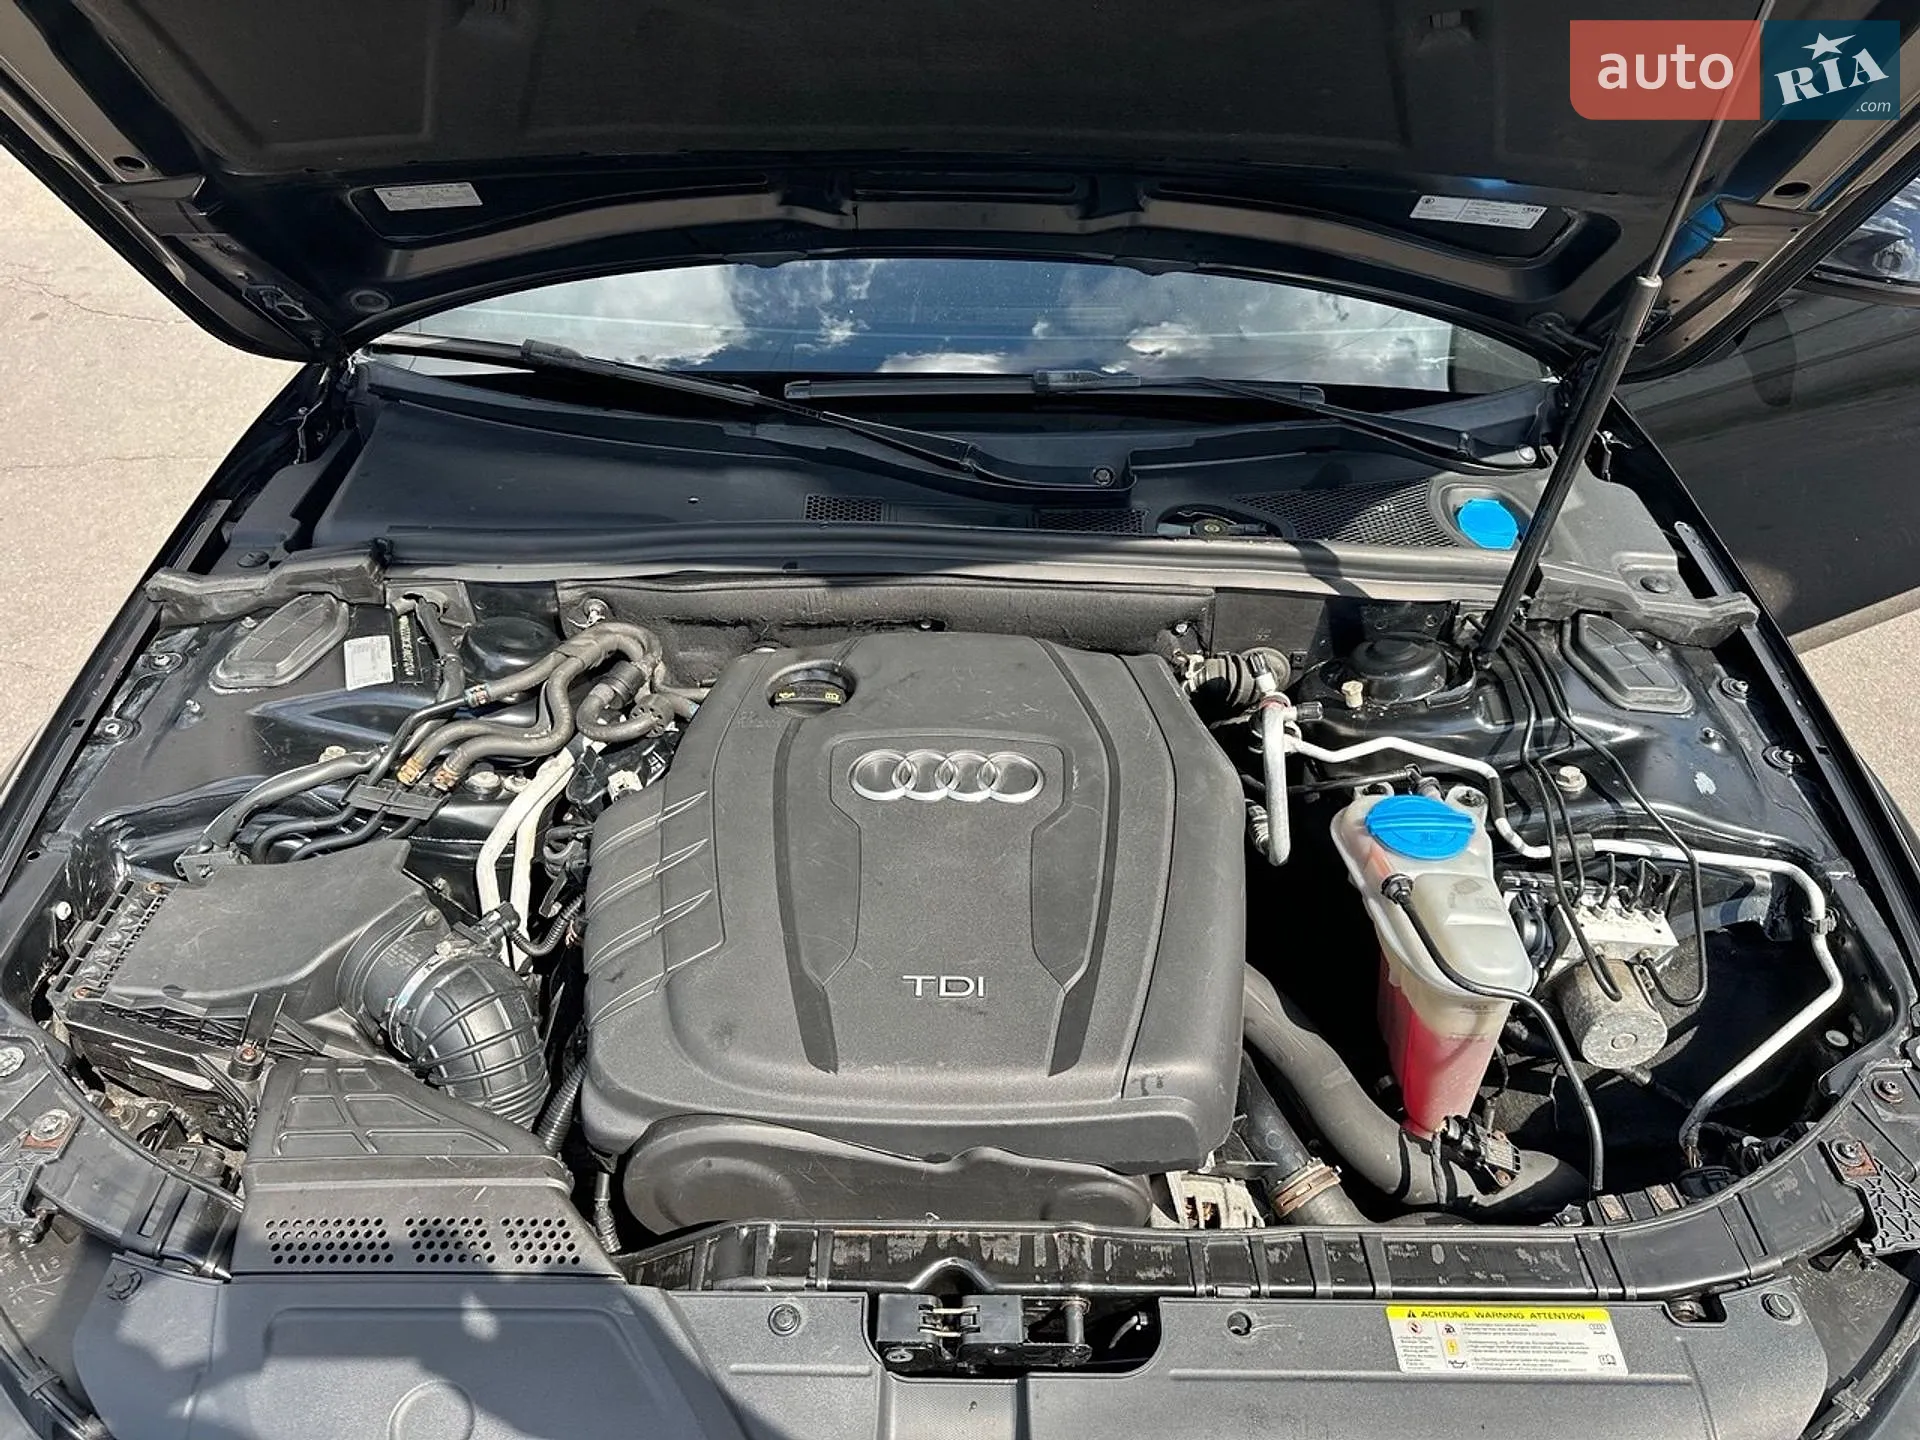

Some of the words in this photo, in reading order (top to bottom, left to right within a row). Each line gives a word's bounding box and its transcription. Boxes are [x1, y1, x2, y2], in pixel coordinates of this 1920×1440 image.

[902, 974, 984, 998] TDI
[1420, 1310, 1470, 1319] ACHTUNG
[1475, 1311, 1525, 1319] WARNING
[1529, 1311, 1586, 1320] ATTENTION
